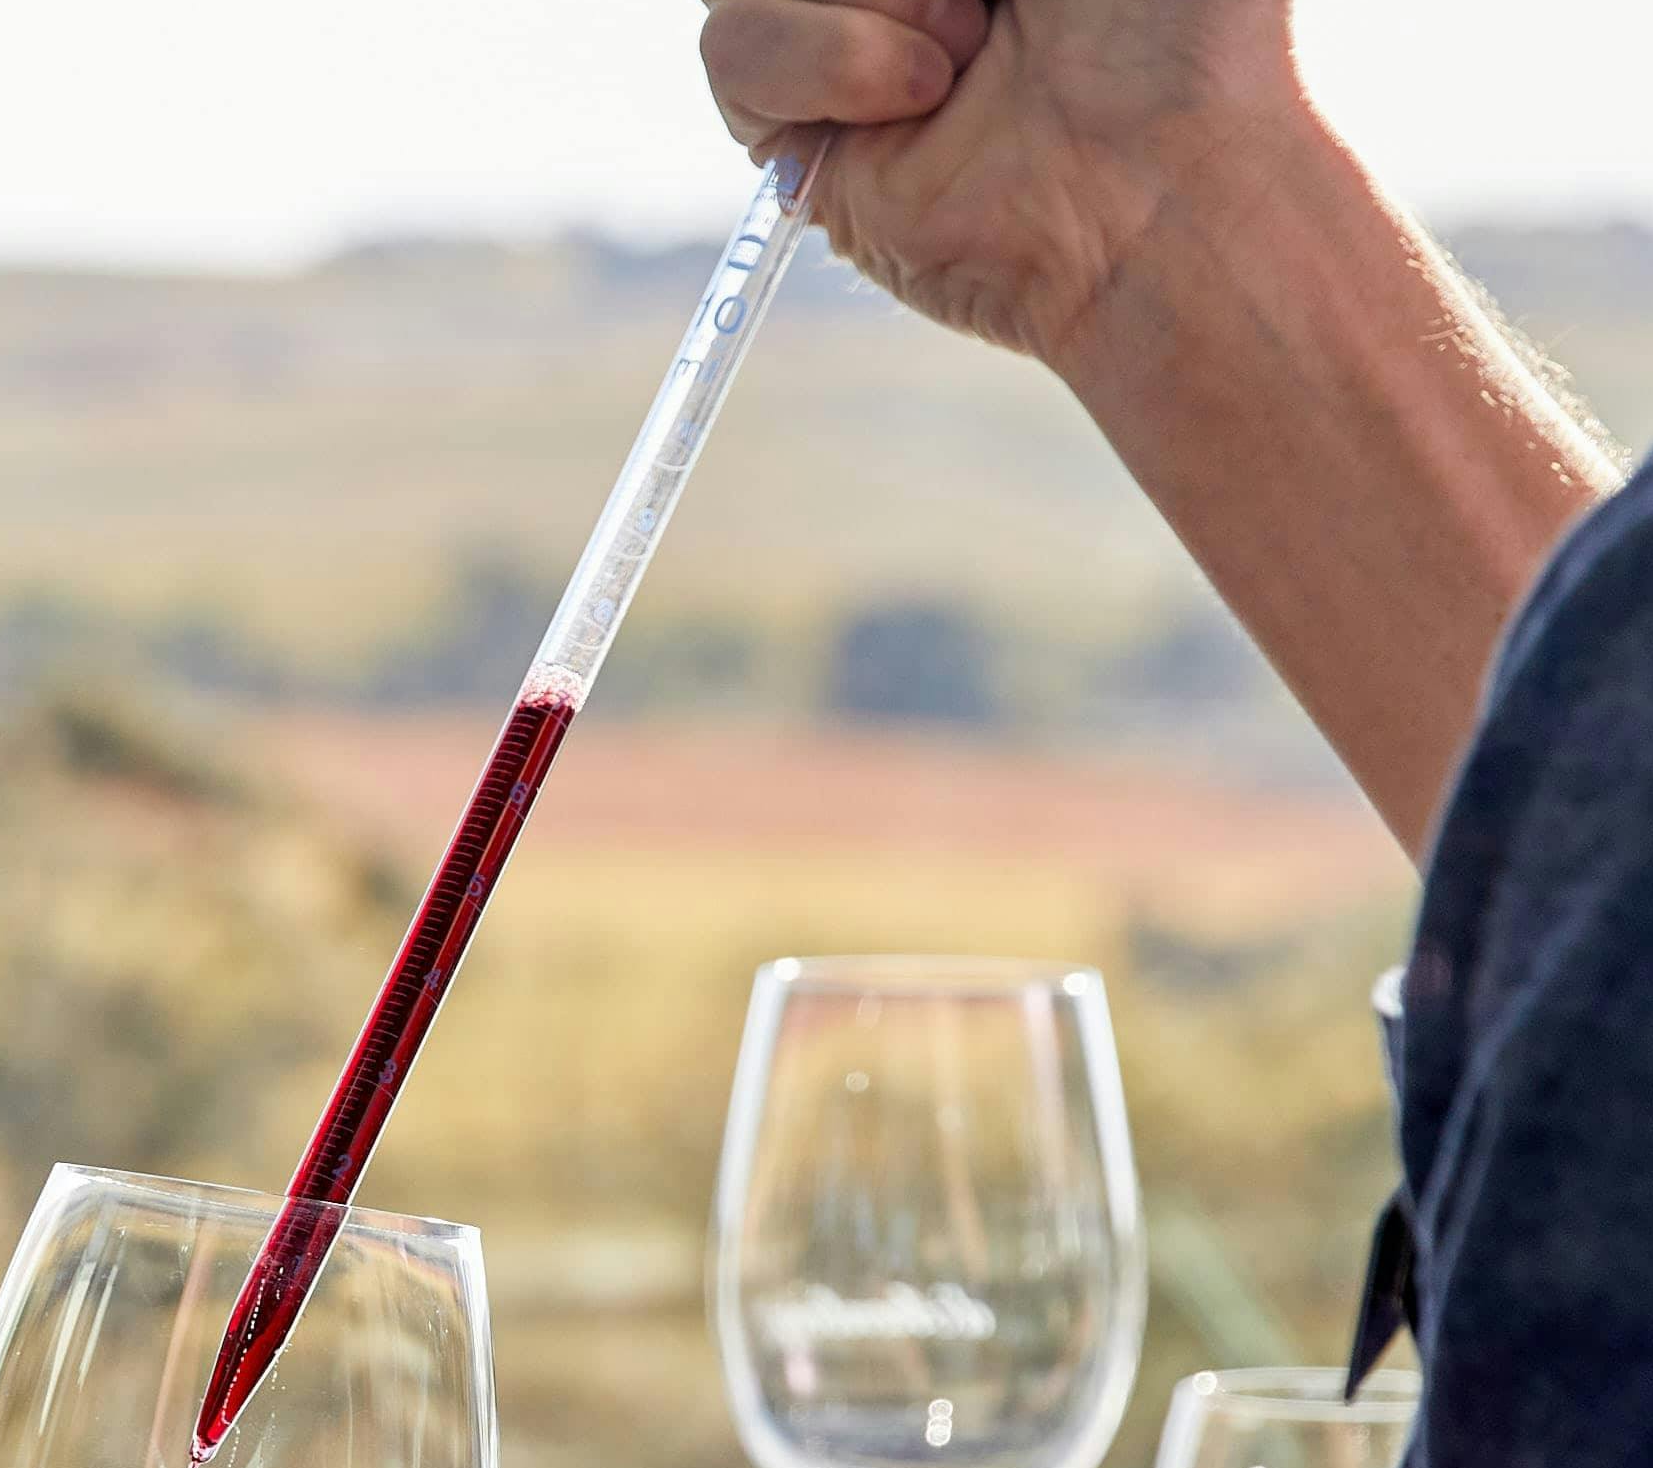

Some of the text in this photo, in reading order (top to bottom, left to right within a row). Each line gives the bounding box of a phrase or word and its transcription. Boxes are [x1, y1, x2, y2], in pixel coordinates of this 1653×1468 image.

[510, 781, 528, 804] 6
[423, 969, 441, 989] 4
[378, 1059, 397, 1084] 3
[332, 1154, 353, 1177] 2
